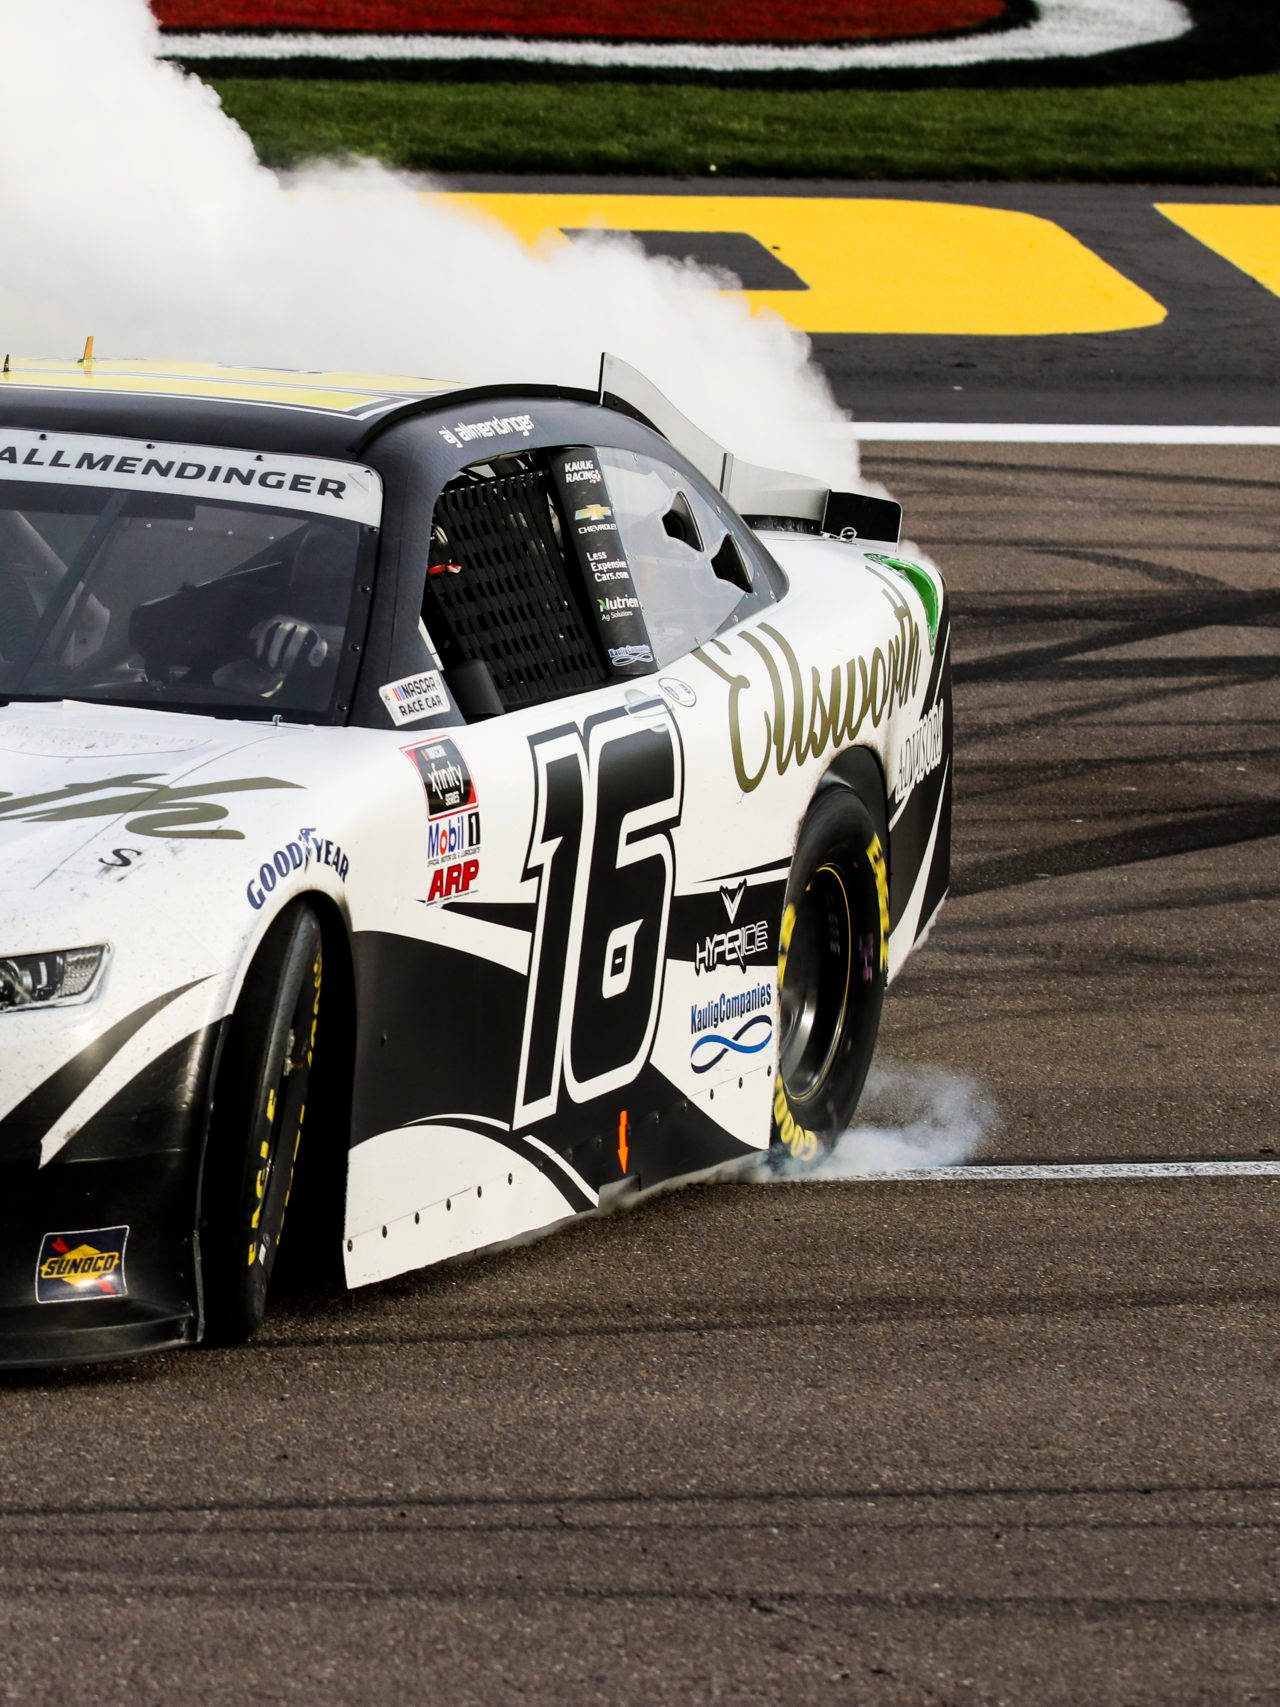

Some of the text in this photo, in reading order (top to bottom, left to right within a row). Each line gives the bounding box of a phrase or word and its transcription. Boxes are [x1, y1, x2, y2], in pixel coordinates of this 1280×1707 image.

[565, 460, 594, 472] KAULIG
[565, 470, 596, 483] RACING
[586, 551, 607, 561] Less
[594, 571, 629, 582] Cars.com
[401, 677, 438, 699] NASCAR
[690, 566, 921, 793] Ellsworth
[399, 695, 442, 716] RACE CAR
[428, 812, 480, 859] Mobil 1
[427, 859, 479, 902] ARP
[514, 698, 685, 1130] 16
[696, 920, 768, 970] HYPERICE
[44, 1254, 115, 1276] SUNOCO
